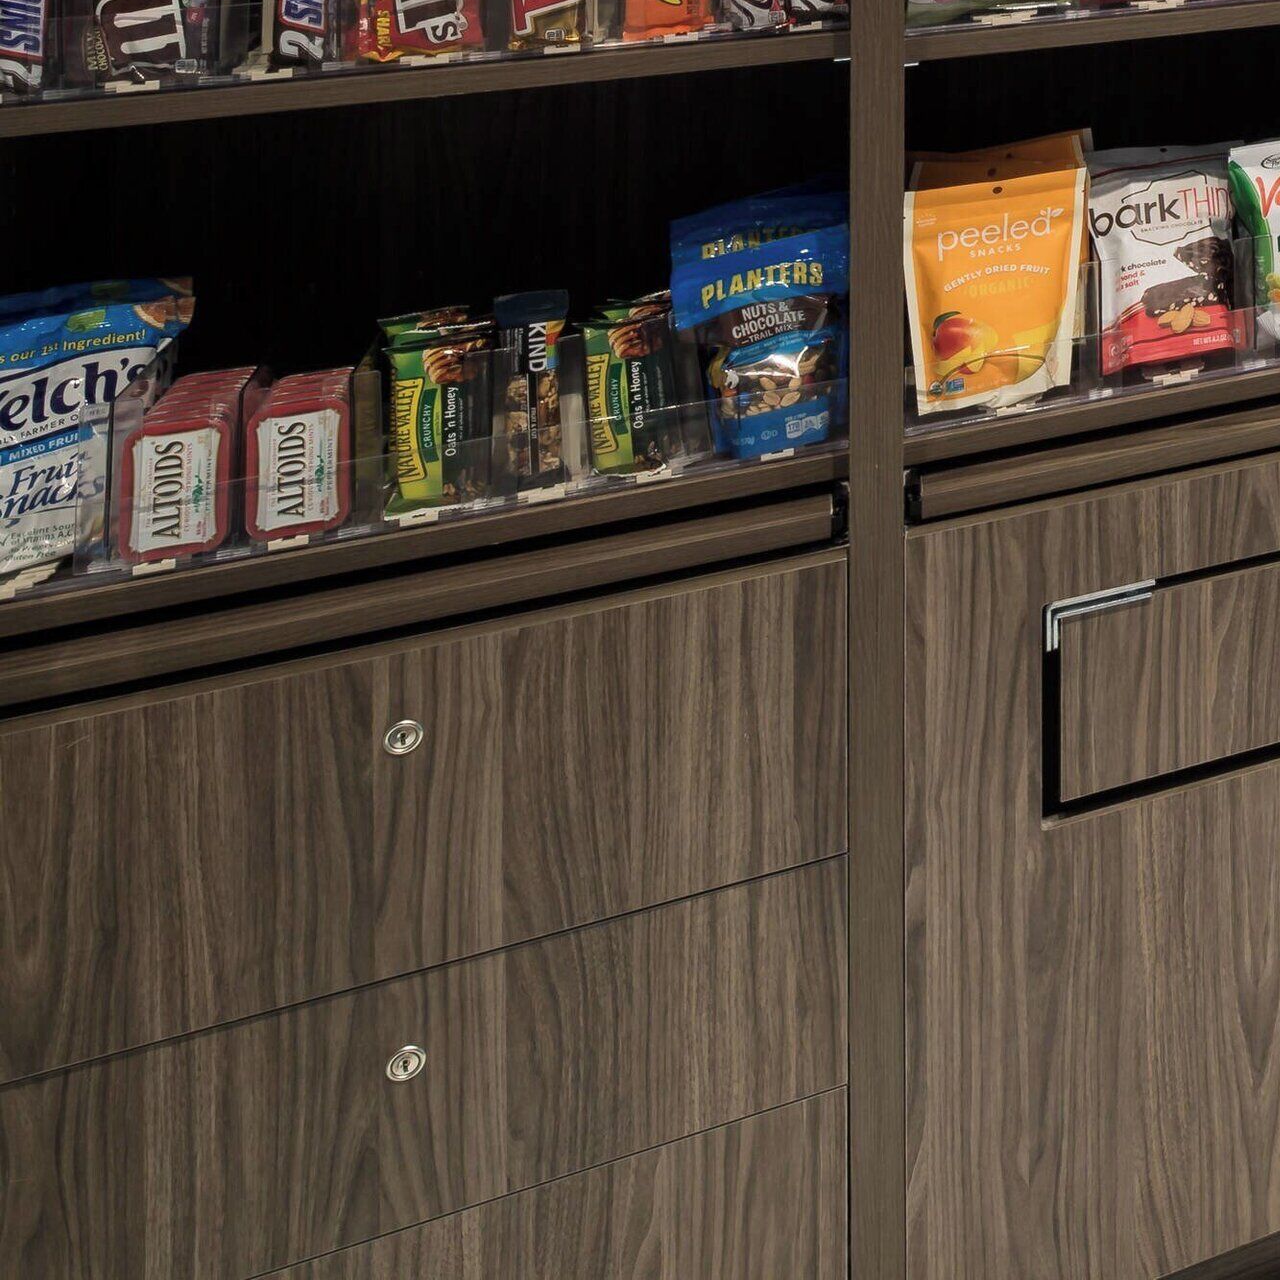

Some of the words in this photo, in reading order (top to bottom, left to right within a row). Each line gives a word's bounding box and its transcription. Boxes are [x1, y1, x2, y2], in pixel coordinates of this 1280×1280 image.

[936, 206, 1054, 262] peeled
[968, 242, 1023, 258] SNACKS
[1127, 258, 1167, 271] chocolate
[701, 261, 824, 310] PLANTERS
[943, 269, 983, 293] GENTLY
[985, 263, 1018, 275] DRIED
[1019, 264, 1052, 276] FRUIT
[732, 310, 807, 340] CHOCOLATE
[741, 303, 777, 321] NUTS
[778, 301, 791, 312] &
[10, 350, 35, 363] our
[63, 329, 147, 351] Ingredient!
[528, 322, 547, 373] KIND
[749, 330, 776, 344] TRAIL
[777, 325, 793, 337] MIX
[630, 361, 643, 392] Honey
[444, 386, 459, 417] Honey
[20, 419, 65, 439] FARMER
[423, 403, 432, 449] CRUNCHY
[632, 407, 645, 430] Oats
[9, 443, 46, 461] MIXED
[444, 431, 457, 457] Oats
[276, 421, 307, 518] ALTOIDS
[151, 439, 184, 539] ALTOIDS
